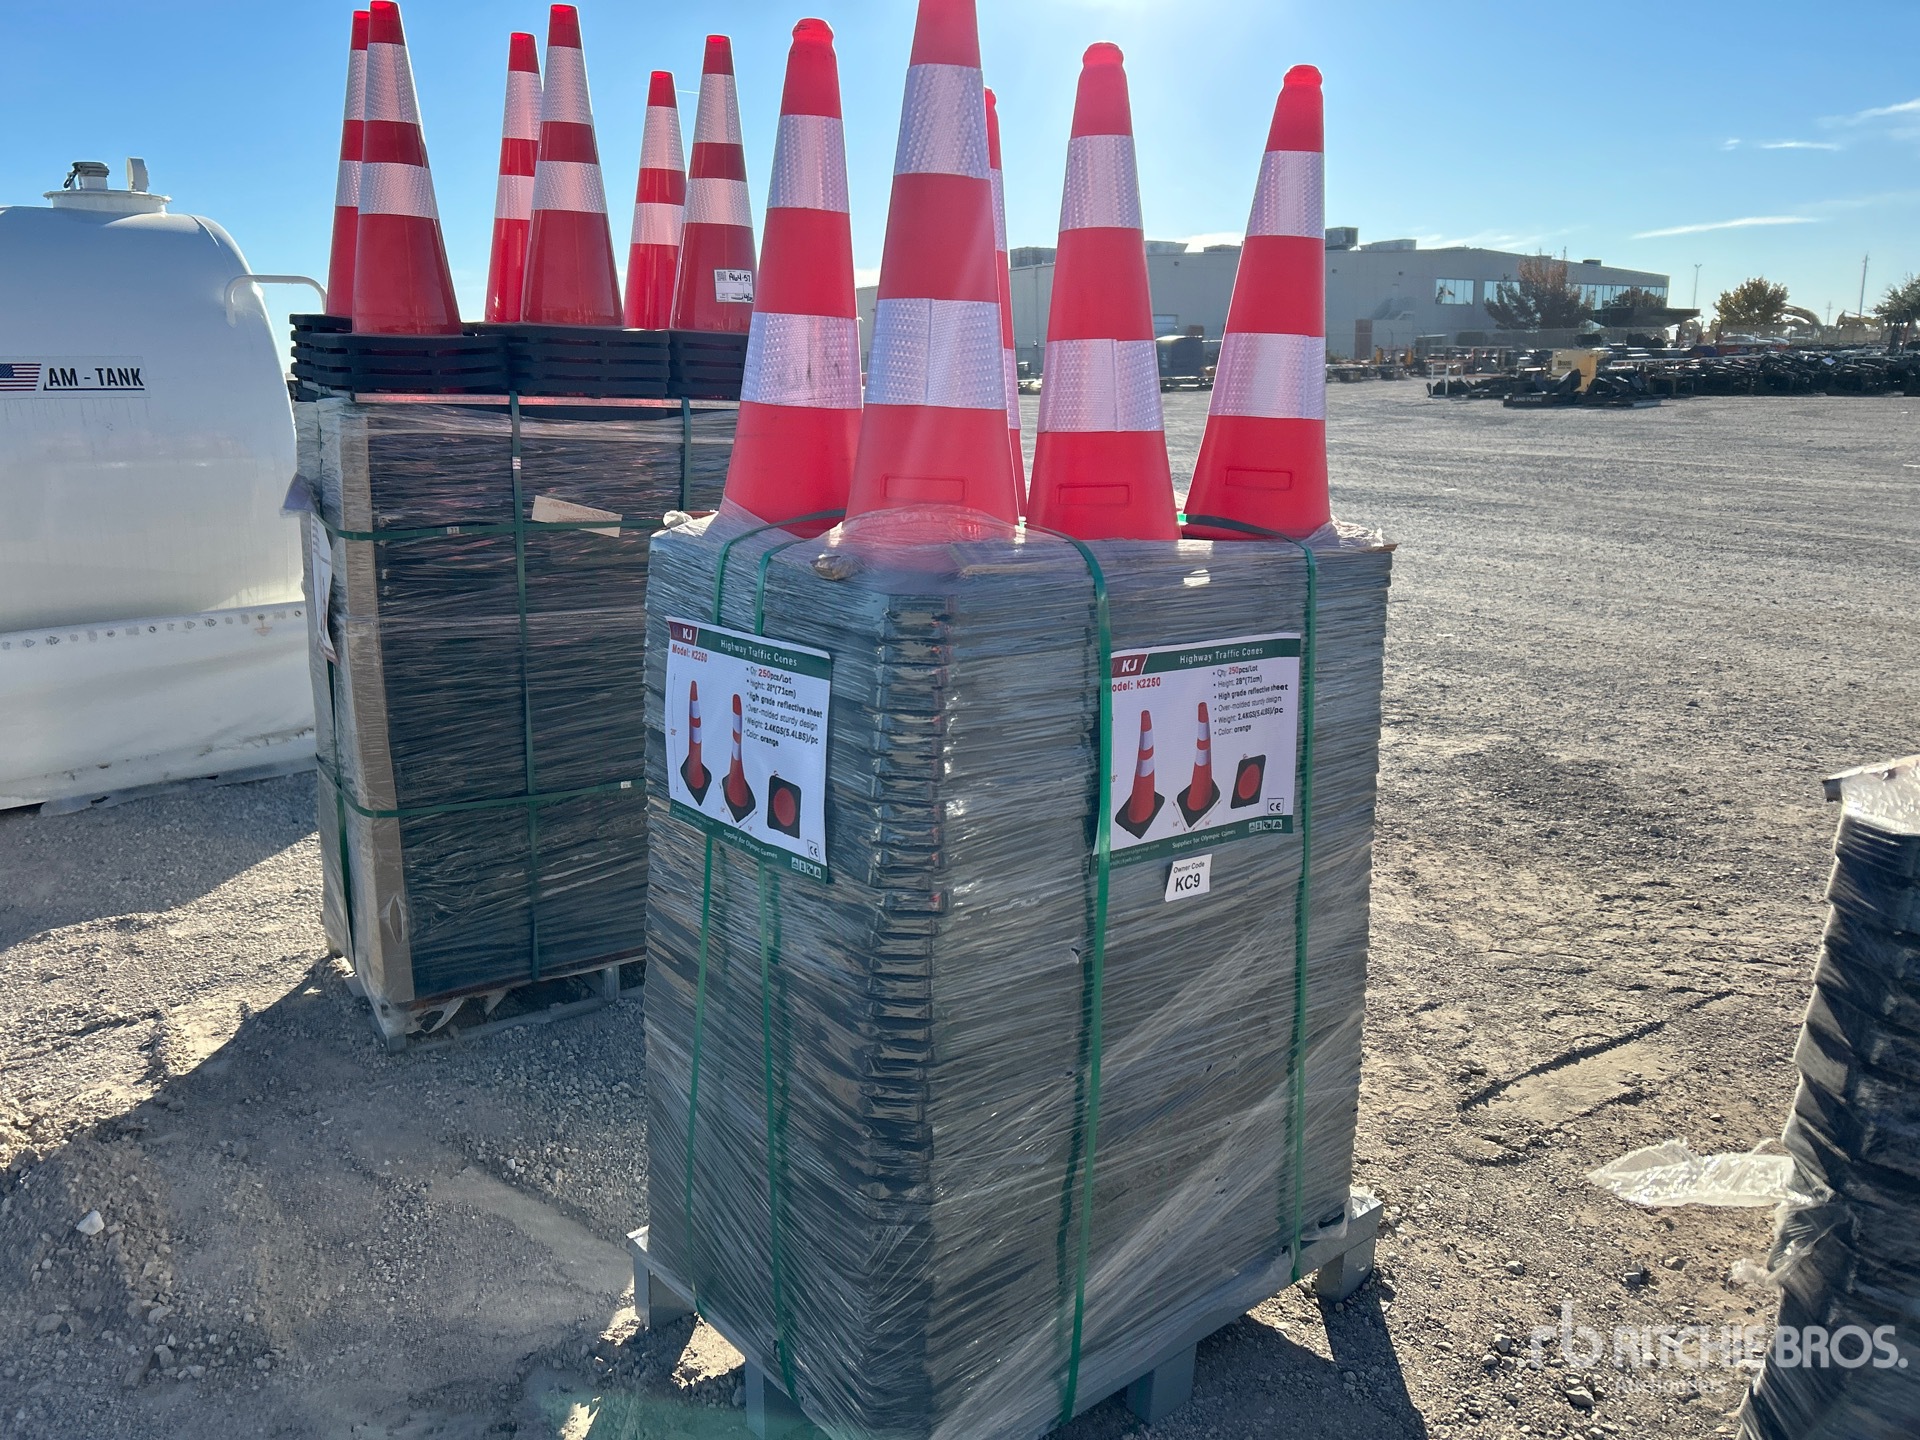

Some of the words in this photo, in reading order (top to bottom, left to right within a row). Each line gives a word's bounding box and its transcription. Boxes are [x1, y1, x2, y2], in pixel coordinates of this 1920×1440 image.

[48, 367, 79, 386] AM
[94, 367, 144, 386] TANK
[682, 627, 693, 640] KJ
[671, 643, 690, 657] Model:
[691, 650, 708, 662] K2250
[720, 639, 747, 656] Highway
[749, 647, 772, 661] Traffic
[773, 653, 798, 667] Cones
[1179, 653, 1212, 665] Highway
[1215, 649, 1240, 660] Traffic
[1241, 646, 1263, 657] Cones
[1121, 658, 1139, 673] KJ
[1112, 680, 1134, 692] odel:
[1136, 676, 1161, 689] K2250
[1218, 691, 1230, 701] High
[1231, 689, 1247, 699] grade
[1247, 685, 1271, 695] reflective
[1270, 683, 1289, 692] sheet
[748, 691, 760, 702] High
[761, 696, 776, 707] grade
[777, 701, 806, 713] reflective
[806, 707, 823, 719] sheet
[1251, 698, 1265, 707] sturdy
[1265, 695, 1282, 704] design
[780, 714, 798, 726] sturdy
[799, 719, 818, 731] design
[1233, 724, 1252, 732] orange
[760, 735, 779, 747] orange
[738, 836, 746, 844] for
[760, 848, 778, 859] Games
[1172, 839, 1193, 849] Supplier
[1193, 836, 1201, 844] for
[1200, 833, 1220, 842] Olympic
[1221, 829, 1237, 837] Games
[1173, 864, 1191, 874] Owner
[1191, 861, 1206, 870] Code
[1174, 872, 1201, 893] KC9
